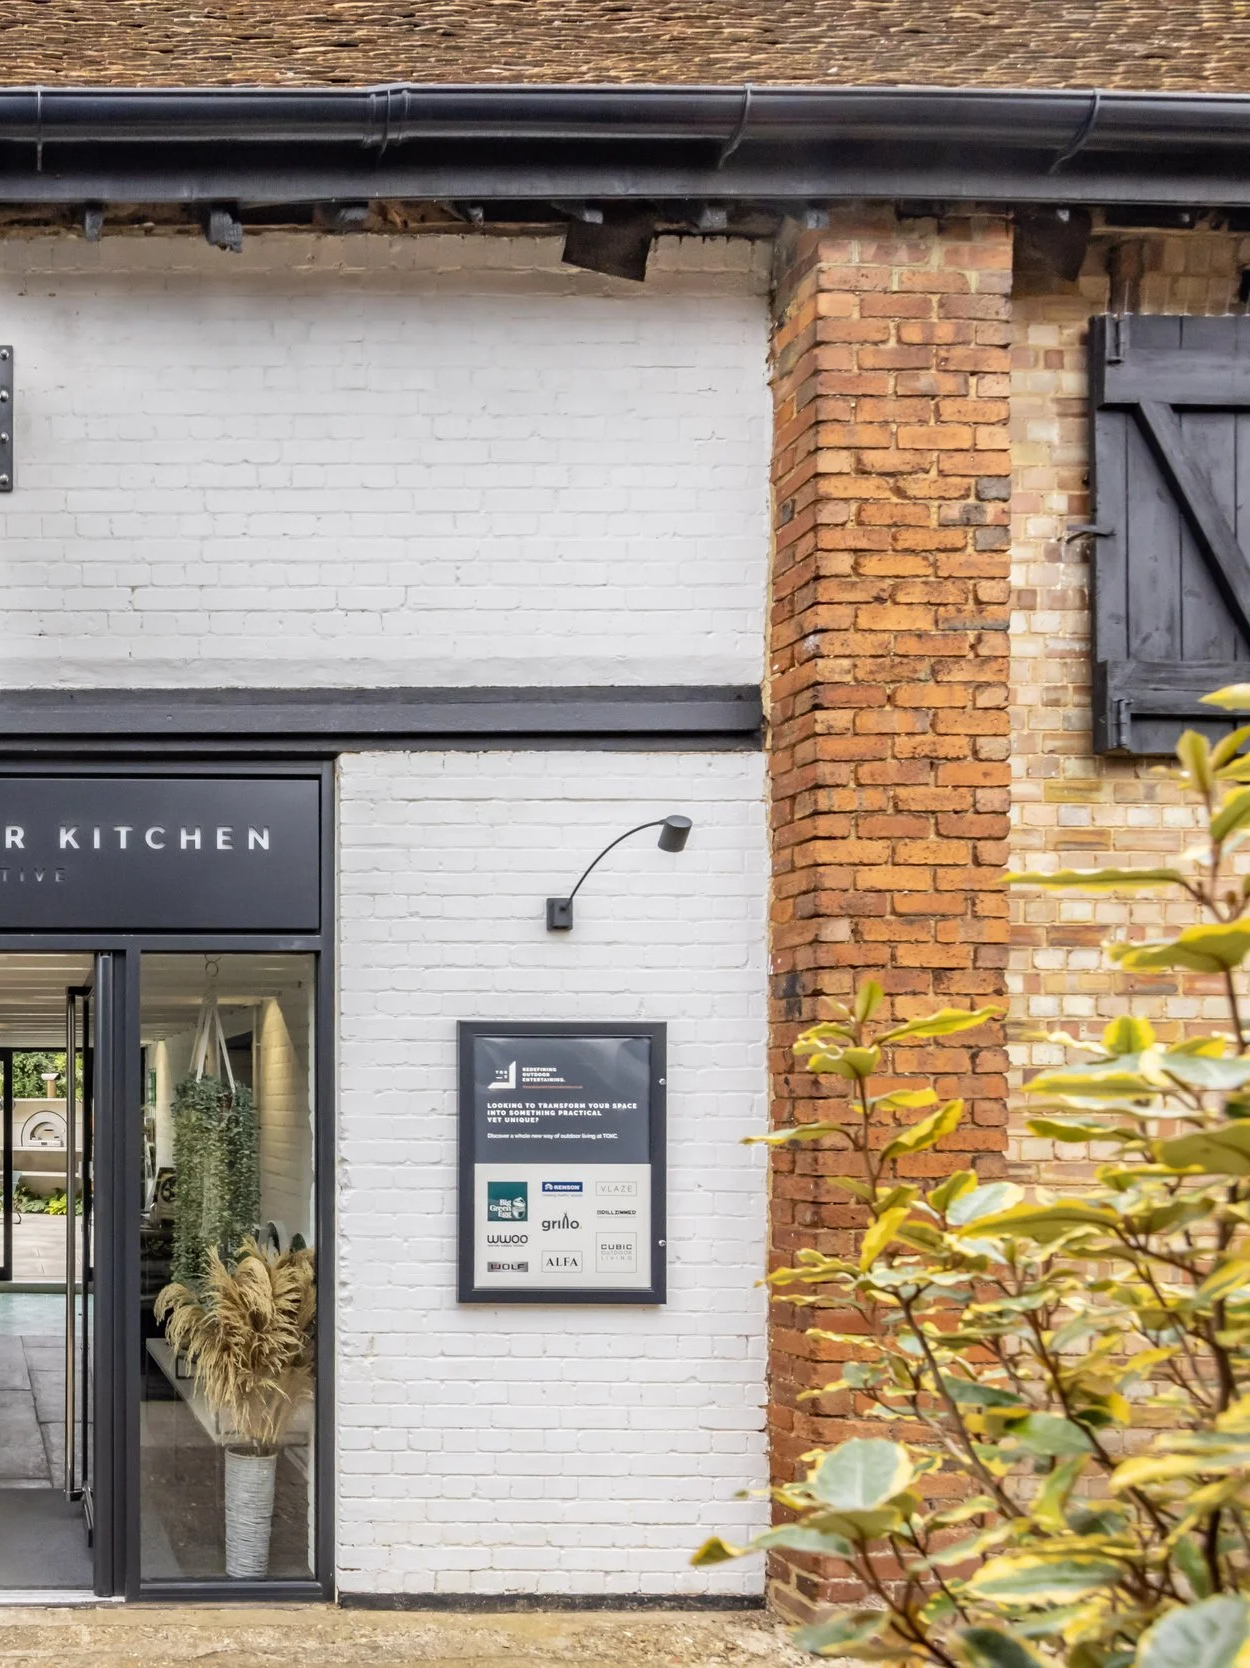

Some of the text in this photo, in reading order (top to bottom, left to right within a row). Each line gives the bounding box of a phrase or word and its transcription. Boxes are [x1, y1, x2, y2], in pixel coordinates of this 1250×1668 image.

[59, 825, 272, 850] KITCHEN
[500, 1199, 512, 1207] Big
[546, 1257, 578, 1267] ALFA
